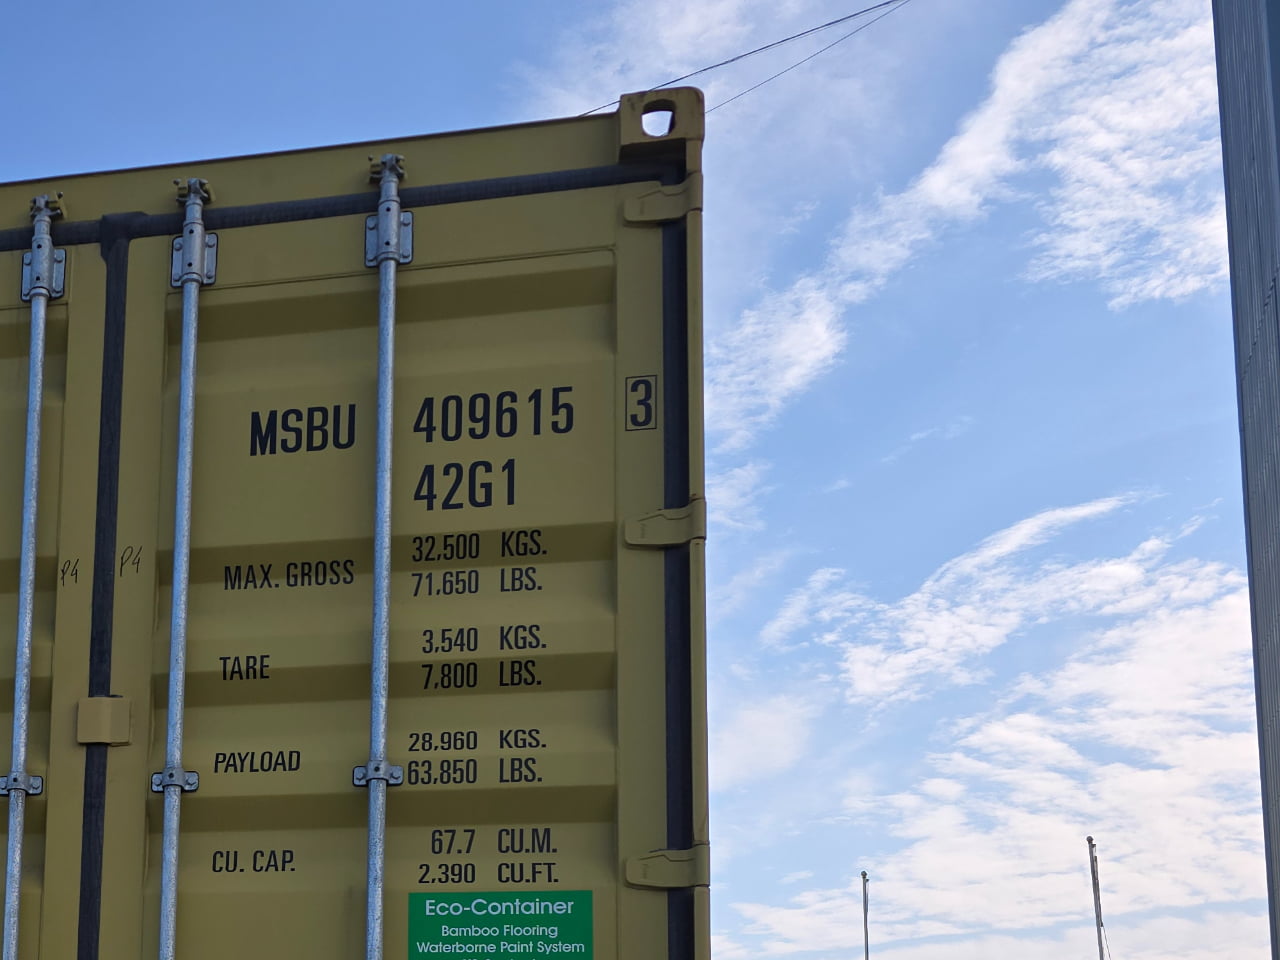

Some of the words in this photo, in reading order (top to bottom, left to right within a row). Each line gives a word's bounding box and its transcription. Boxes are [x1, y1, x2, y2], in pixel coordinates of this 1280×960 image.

[249, 403, 357, 457] MSBU
[412, 386, 575, 443] 409615
[629, 378, 654, 428] 3
[413, 458, 517, 512] 42G1
[500, 529, 548, 558] KGS.
[223, 563, 280, 590] MAX.
[286, 559, 355, 588] GROSS
[499, 566, 543, 593] LBS.
[499, 624, 548, 651] KGS.
[219, 654, 271, 681] TARE
[499, 659, 542, 687] LBS.
[499, 728, 548, 749] KGS.
[213, 750, 302, 774] PAYLOAD
[498, 757, 543, 784] LBS.
[430, 829, 477, 855] 67.7
[497, 827, 558, 854] CU.M.
[211, 850, 245, 873] CU.
[252, 849, 296, 873] CAP.
[497, 861, 559, 884] CU.FT.
[425, 898, 575, 916] Eco-Container
[441, 924, 500, 937] Bamboo
[503, 924, 559, 939] Flooring
[417, 941, 497, 953] Waterborne
[500, 941, 534, 953] Paint
[537, 941, 585, 955] System
